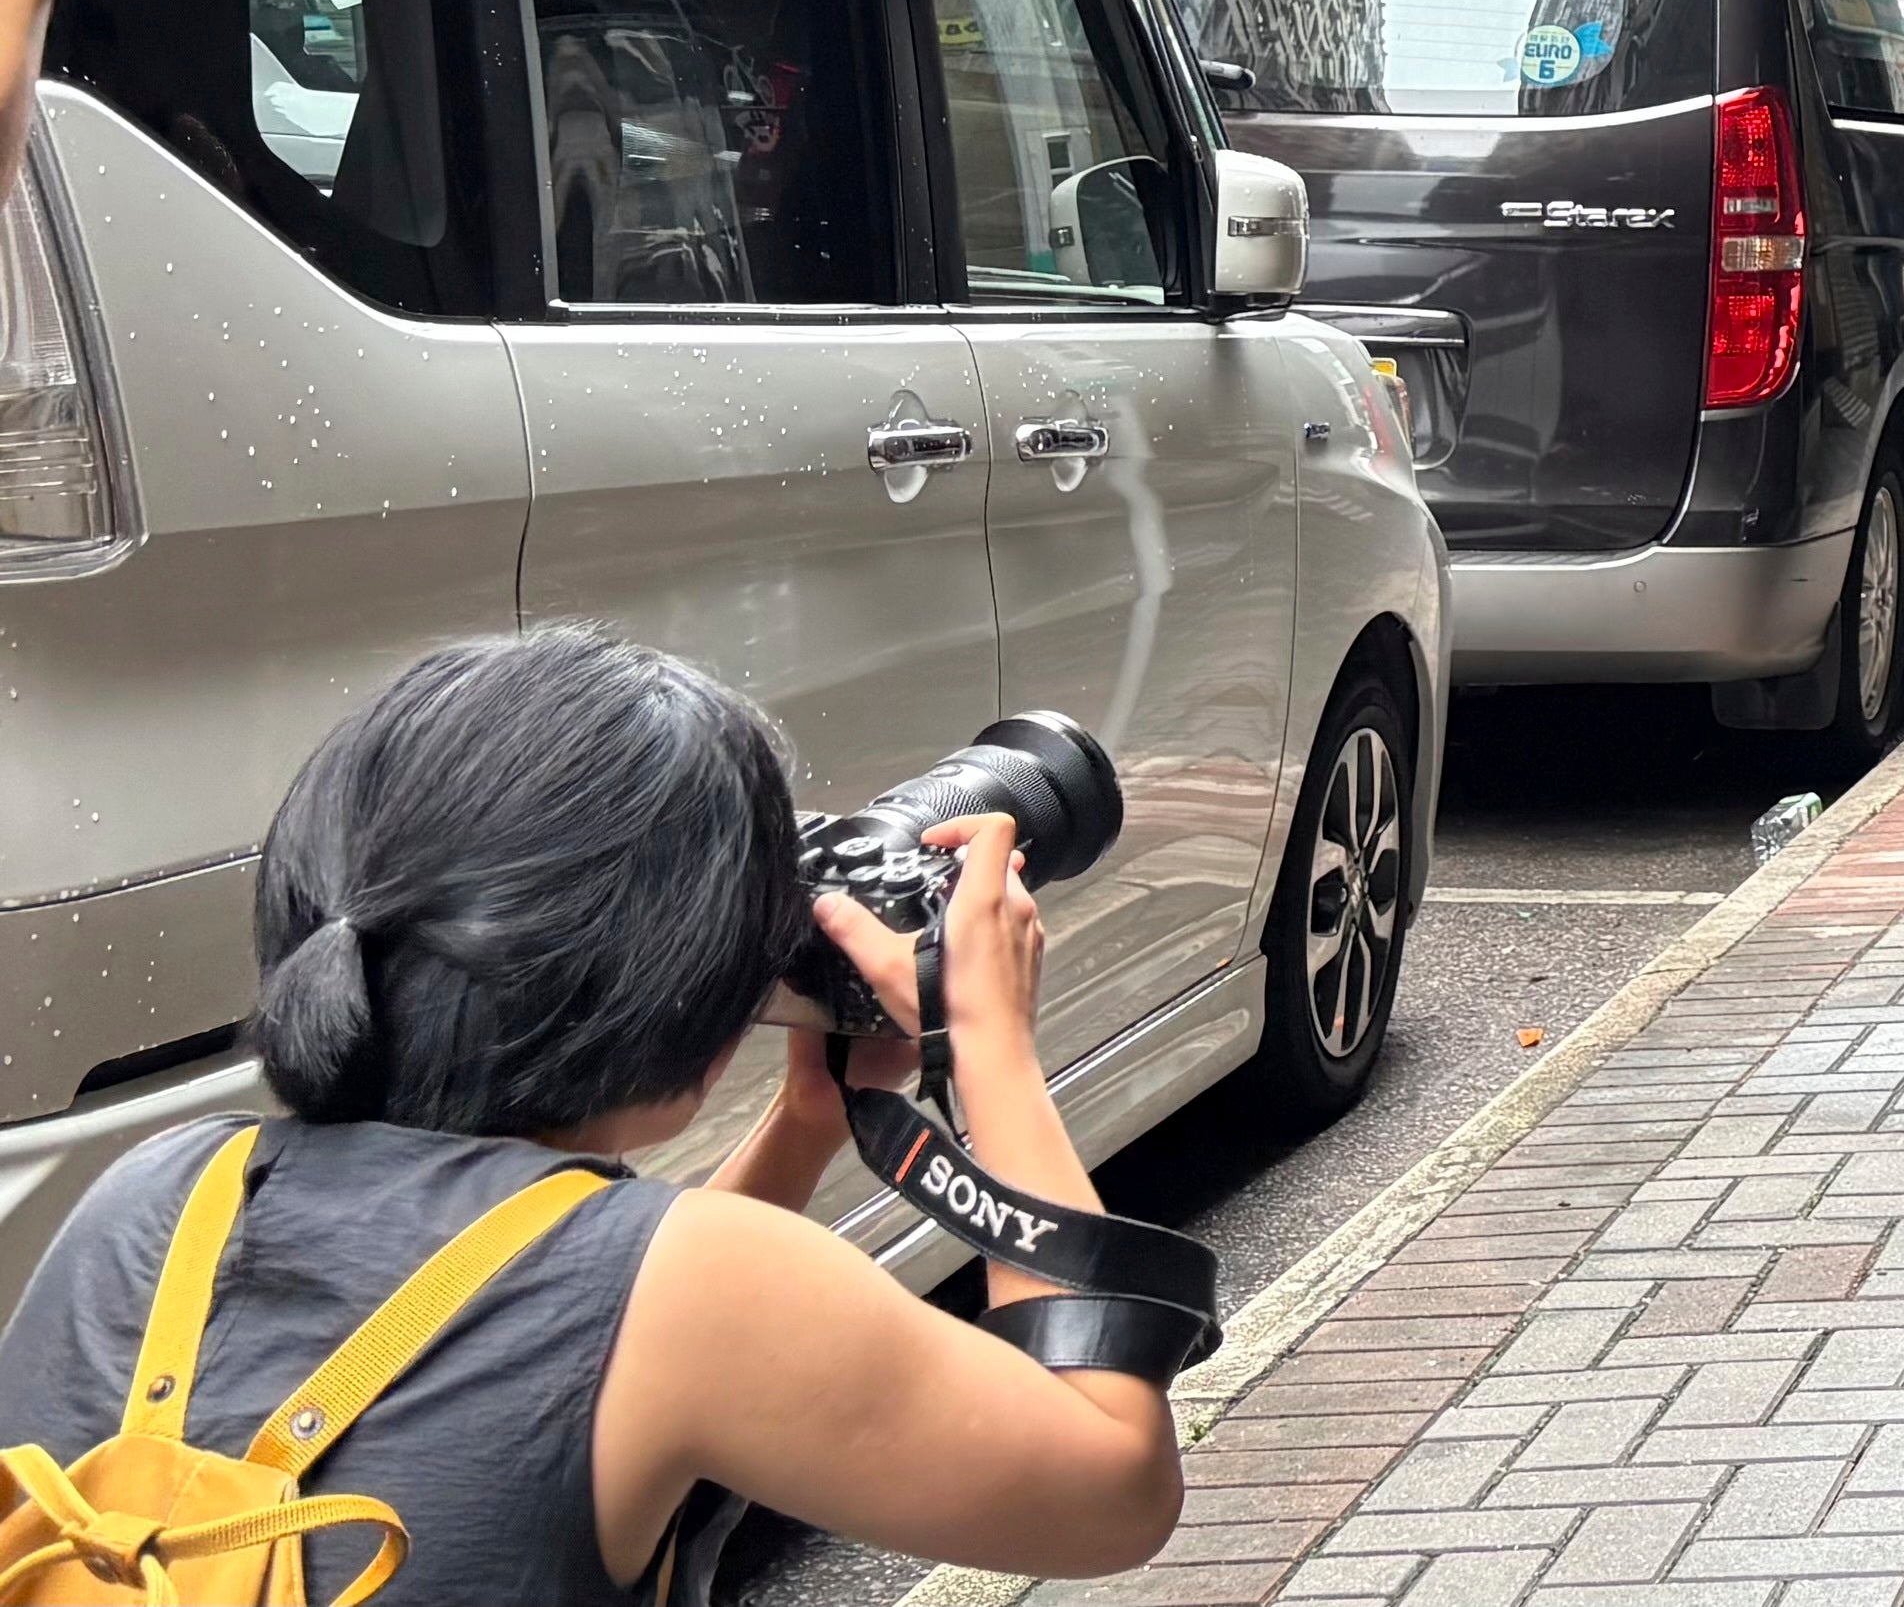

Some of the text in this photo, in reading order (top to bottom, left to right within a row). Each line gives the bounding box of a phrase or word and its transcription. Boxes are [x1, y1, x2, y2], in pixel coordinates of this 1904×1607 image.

[1525, 42, 1573, 60] EURO
[1538, 59, 1556, 80] 6
[1543, 200, 1676, 228] Starex
[920, 1154, 1059, 1253] SONY
